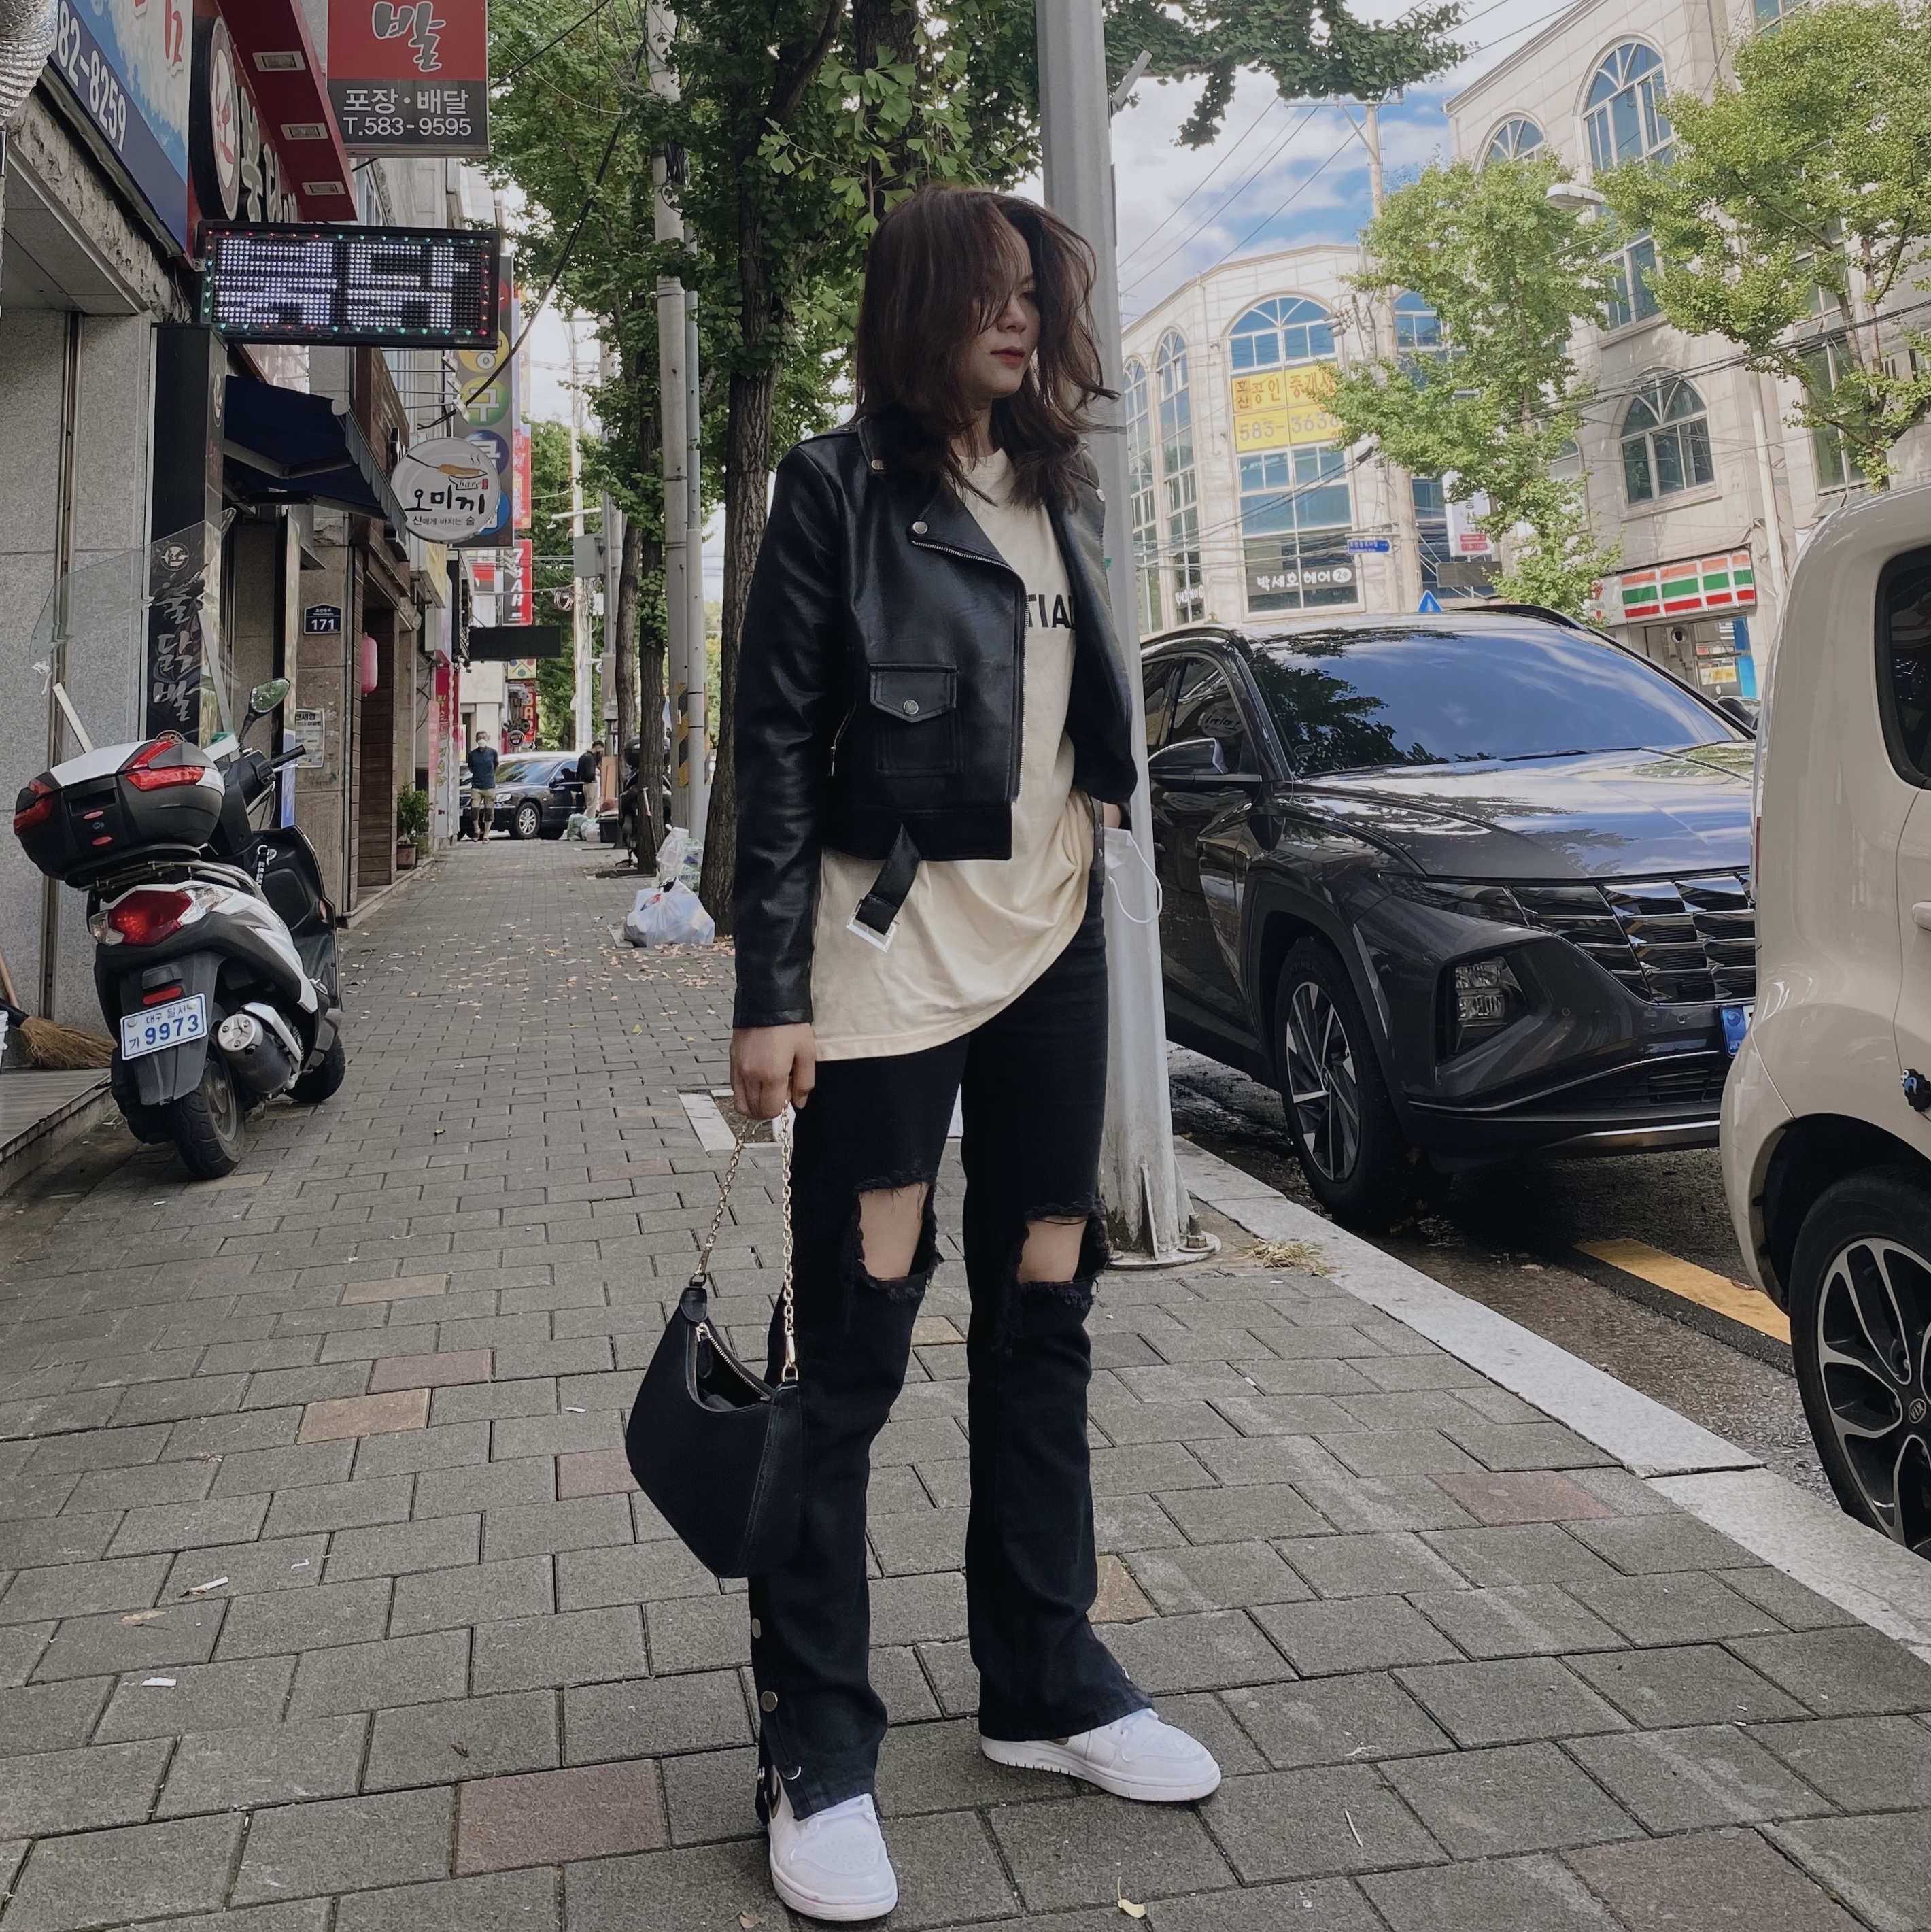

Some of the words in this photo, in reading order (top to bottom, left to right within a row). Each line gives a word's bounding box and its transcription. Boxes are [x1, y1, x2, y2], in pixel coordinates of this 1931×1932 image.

[372, 1, 447, 73] 발
[50, 0, 127, 152] 82-8259
[458, 479, 477, 489] bar
[403, 484, 486, 515] 오미끼
[412, 515, 437, 526] 신에게
[439, 518, 462, 526] 바치는
[465, 515, 476, 526] 술
[1256, 571, 1299, 592] 박세호
[1303, 569, 1331, 584] 헤어
[311, 618, 335, 630] 171
[146, 1012, 163, 1025] 대구
[167, 1005, 186, 1019] 달서
[144, 1013, 199, 1045] 9973
